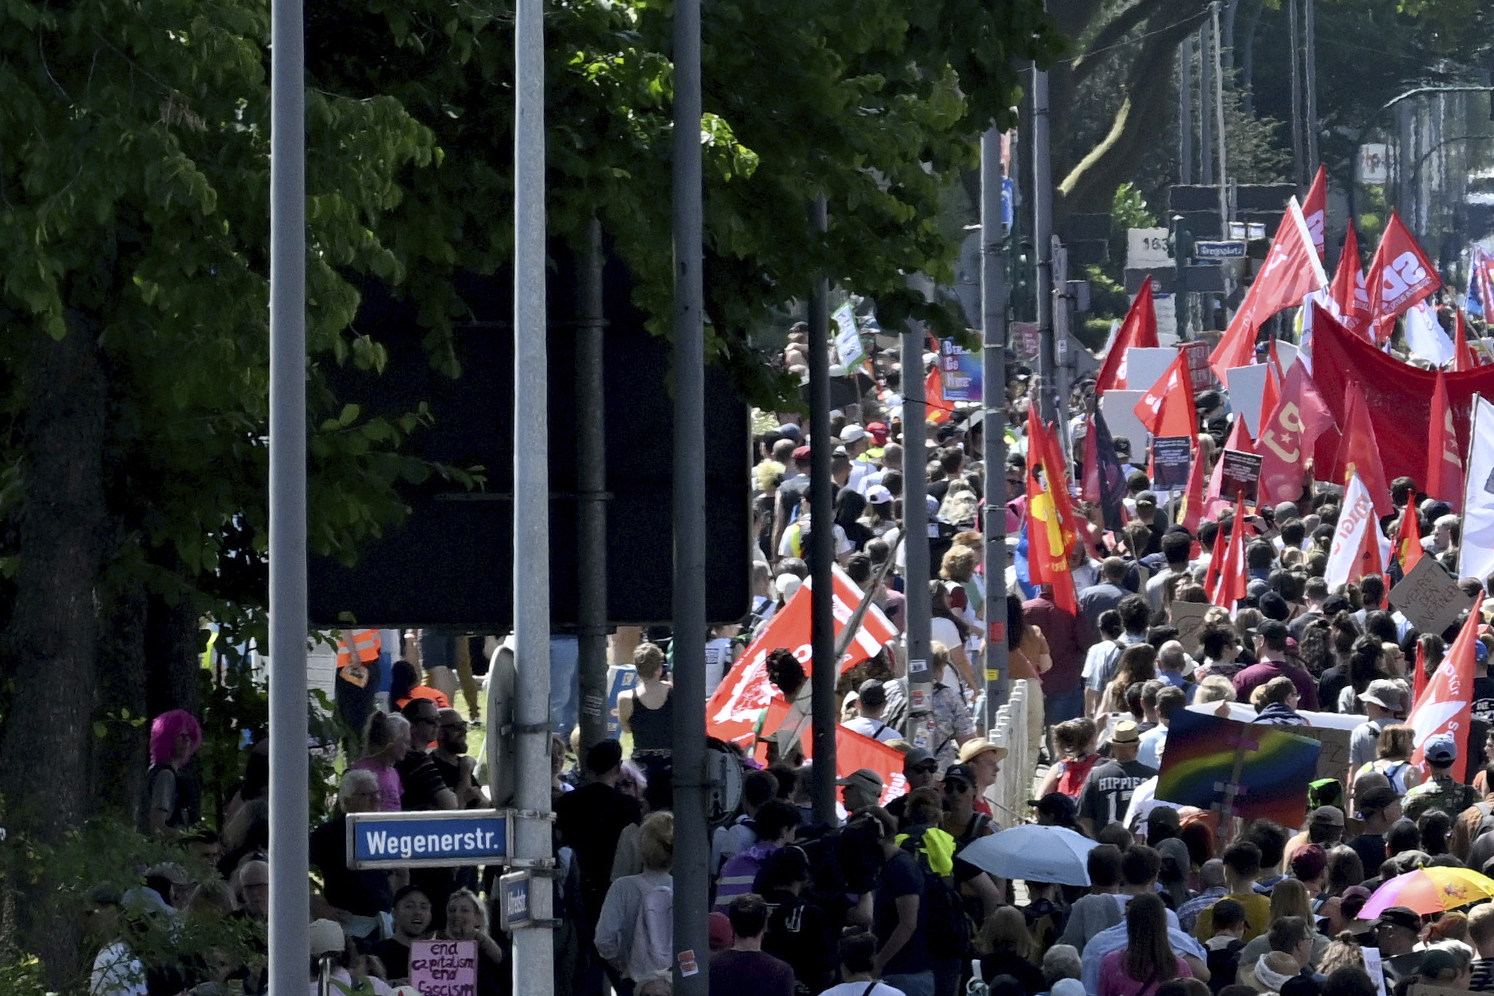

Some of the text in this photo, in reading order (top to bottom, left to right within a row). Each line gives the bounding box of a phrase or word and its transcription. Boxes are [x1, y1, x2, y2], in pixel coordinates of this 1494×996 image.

[367, 828, 499, 859] Wegenerstr.
[430, 941, 458, 956] end
[411, 955, 475, 972] capitalism
[431, 969, 457, 982] end
